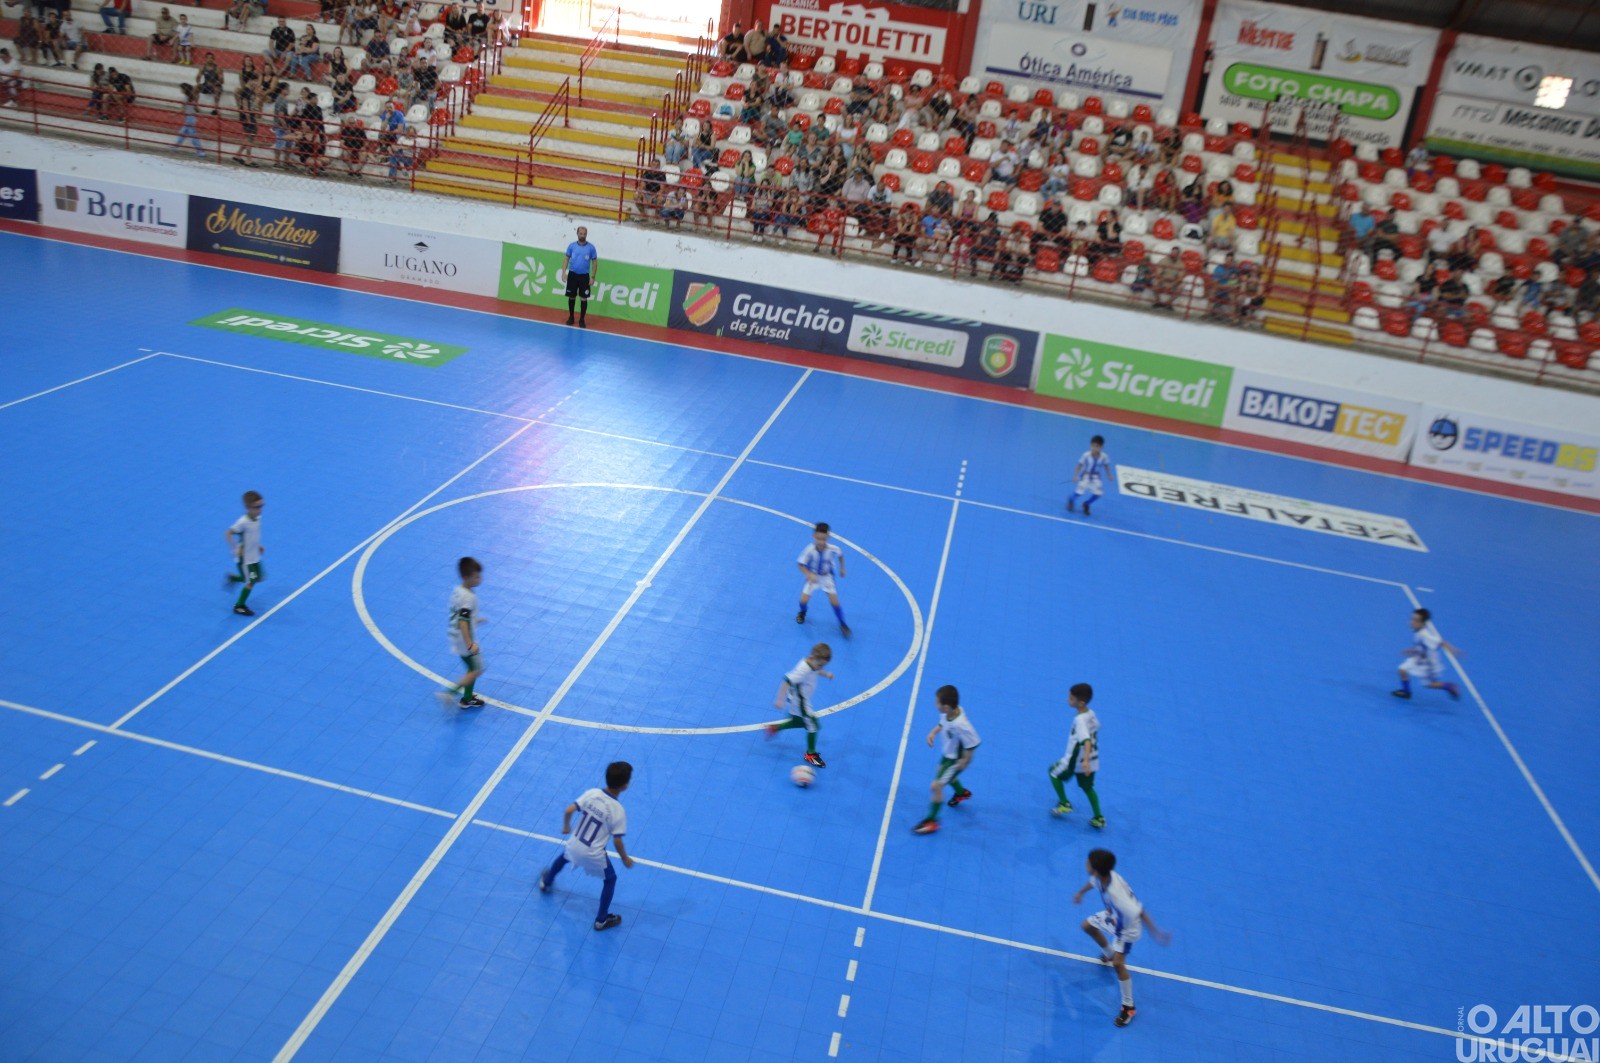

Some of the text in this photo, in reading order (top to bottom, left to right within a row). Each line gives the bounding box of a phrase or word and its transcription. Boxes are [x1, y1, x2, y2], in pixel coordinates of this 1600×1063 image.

[1018, 0, 1058, 25] URI
[780, 13, 932, 55] BERTOLETTI
[1019, 51, 1062, 77] Ótica
[1065, 62, 1133, 88] América
[1234, 71, 1390, 111] FOTO CHAPA
[205, 205, 320, 246] Marathon
[384, 253, 458, 278] LUGANO
[552, 267, 660, 312] Scredi
[215, 315, 385, 348] Sicredi
[729, 318, 791, 342] de futsal
[731, 293, 846, 335] Gauchão
[885, 330, 957, 358] Sicredi
[1096, 360, 1218, 409] Sicredi
[574, 810, 604, 848] 10
